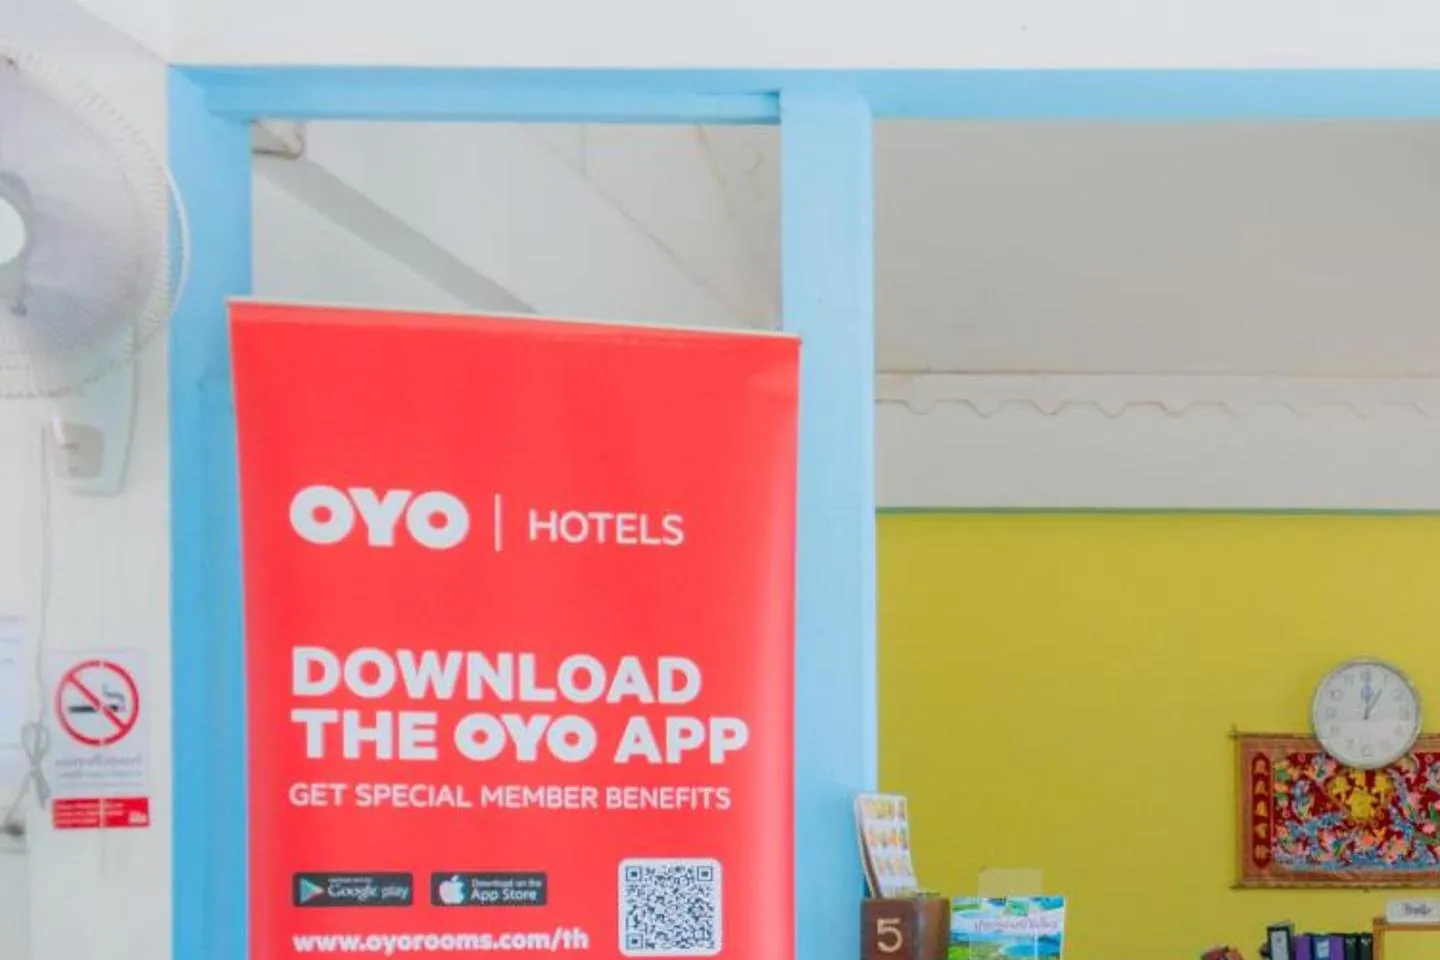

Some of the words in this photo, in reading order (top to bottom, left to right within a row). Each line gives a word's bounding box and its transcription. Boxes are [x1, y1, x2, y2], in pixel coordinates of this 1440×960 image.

[289, 485, 470, 550] OYO
[528, 509, 684, 545] HOTELS
[291, 646, 702, 704] DOWNLOAD
[290, 708, 438, 760] THE
[453, 712, 597, 762] OYO
[614, 716, 749, 764] APP
[289, 782, 345, 807] GET
[355, 784, 472, 807] SPECIAL
[481, 785, 598, 809] MEMBER
[606, 787, 731, 810] BENEFITS
[471, 888, 500, 904] App
[502, 888, 537, 901] Store
[293, 926, 590, 956] www.oyorooms.com/th
[876, 918, 904, 953] 5
